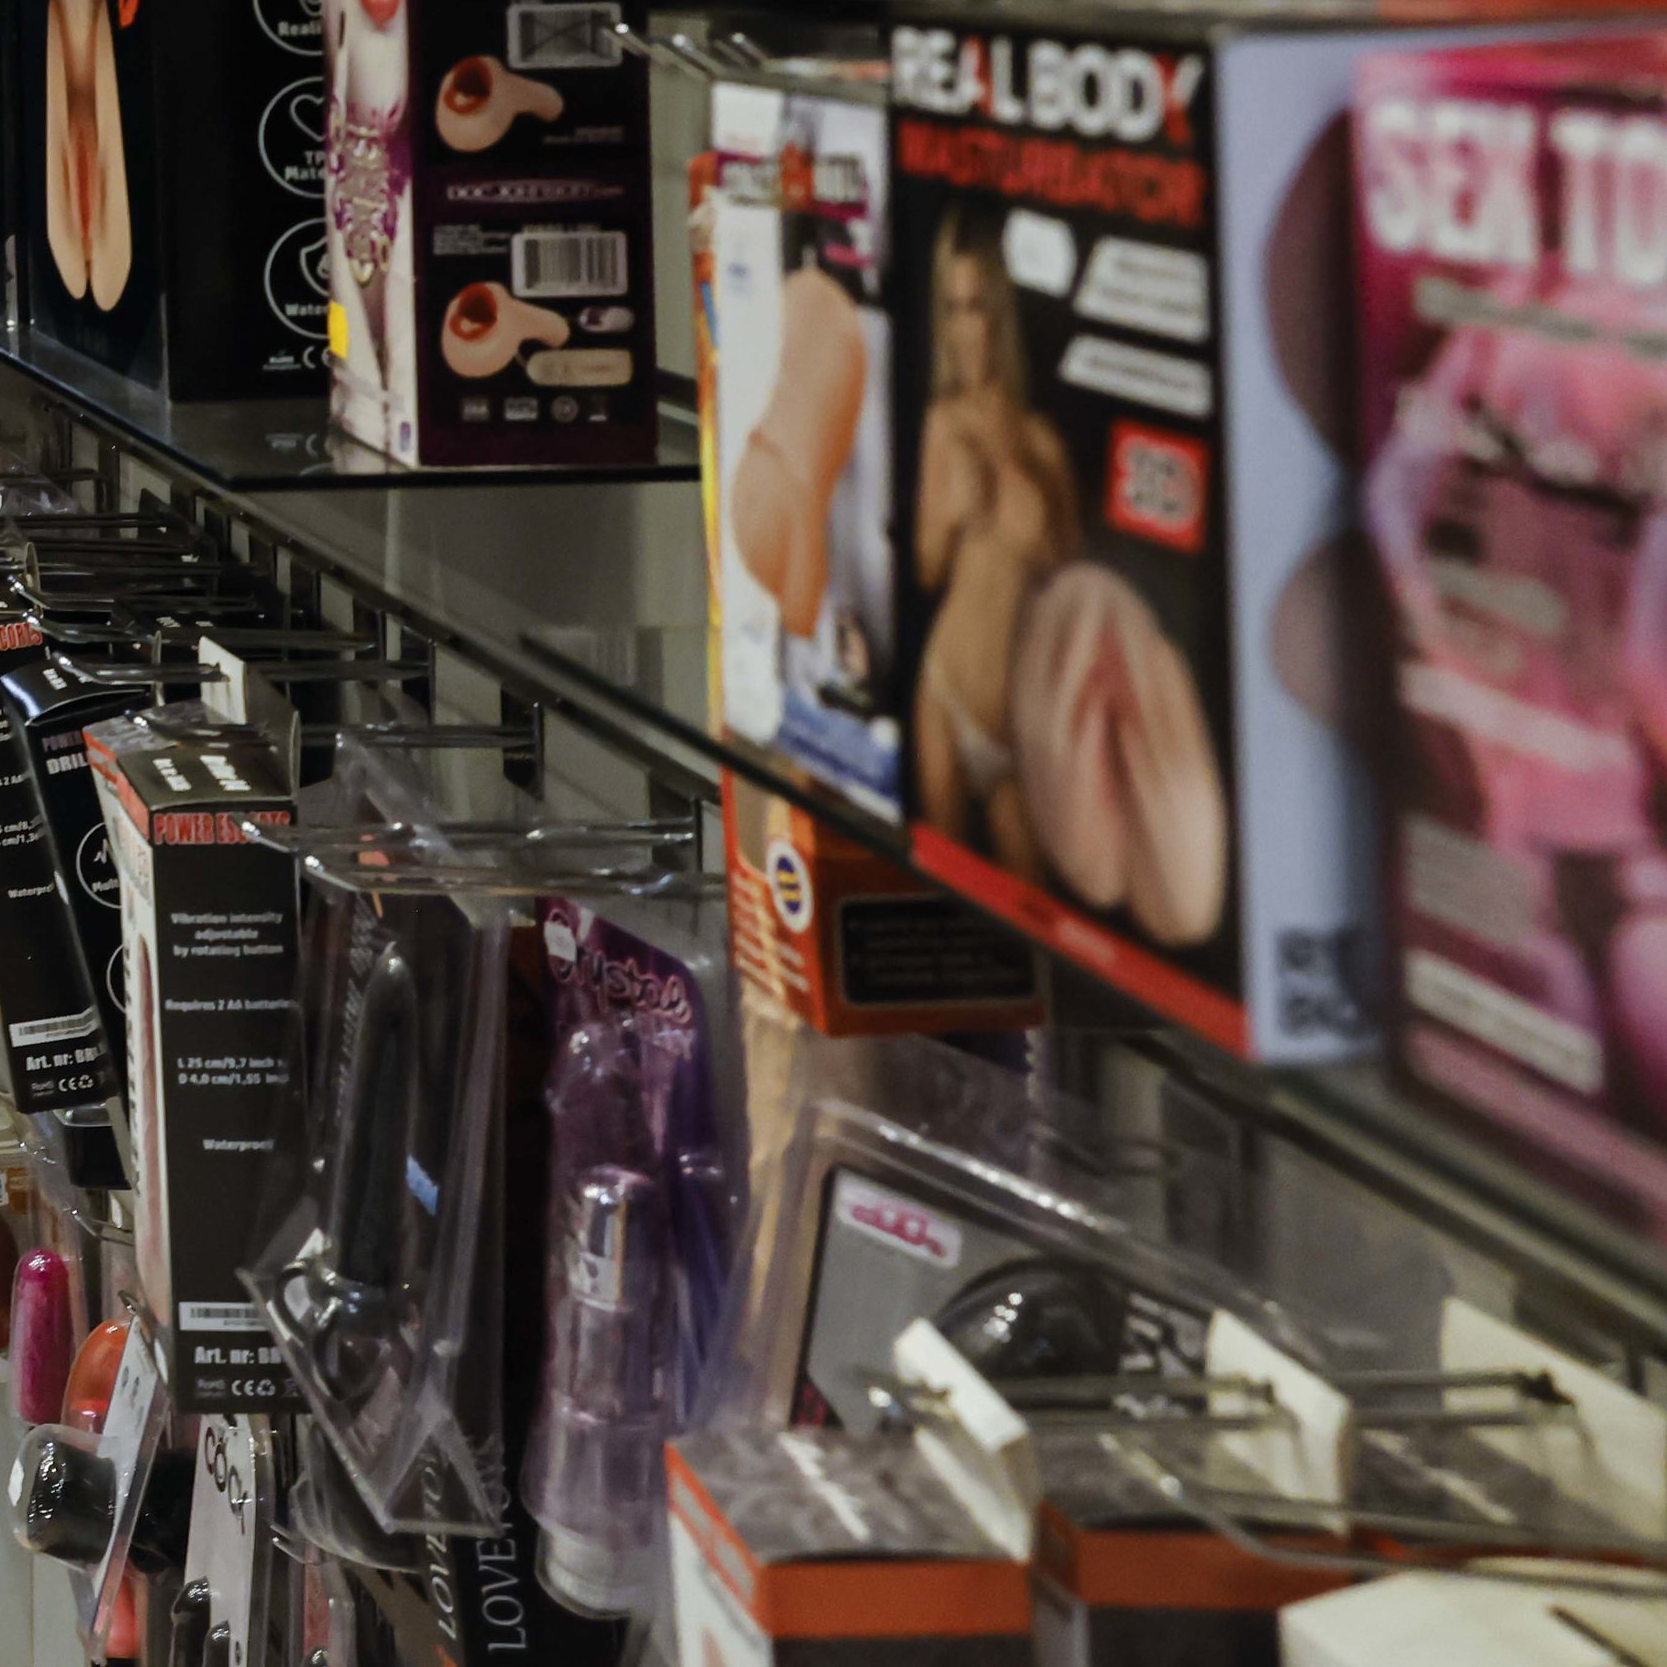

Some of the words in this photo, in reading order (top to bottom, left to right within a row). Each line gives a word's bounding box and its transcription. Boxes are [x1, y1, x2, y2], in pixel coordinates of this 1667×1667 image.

[891, 24, 1028, 126] REAL
[1032, 38, 1207, 146] BODY
[1367, 98, 1539, 263] SEX
[152, 813, 215, 845] POWER
[26, 1054, 52, 1072] Art.
[194, 1345, 227, 1364] Art.
[229, 1348, 255, 1364] nr:
